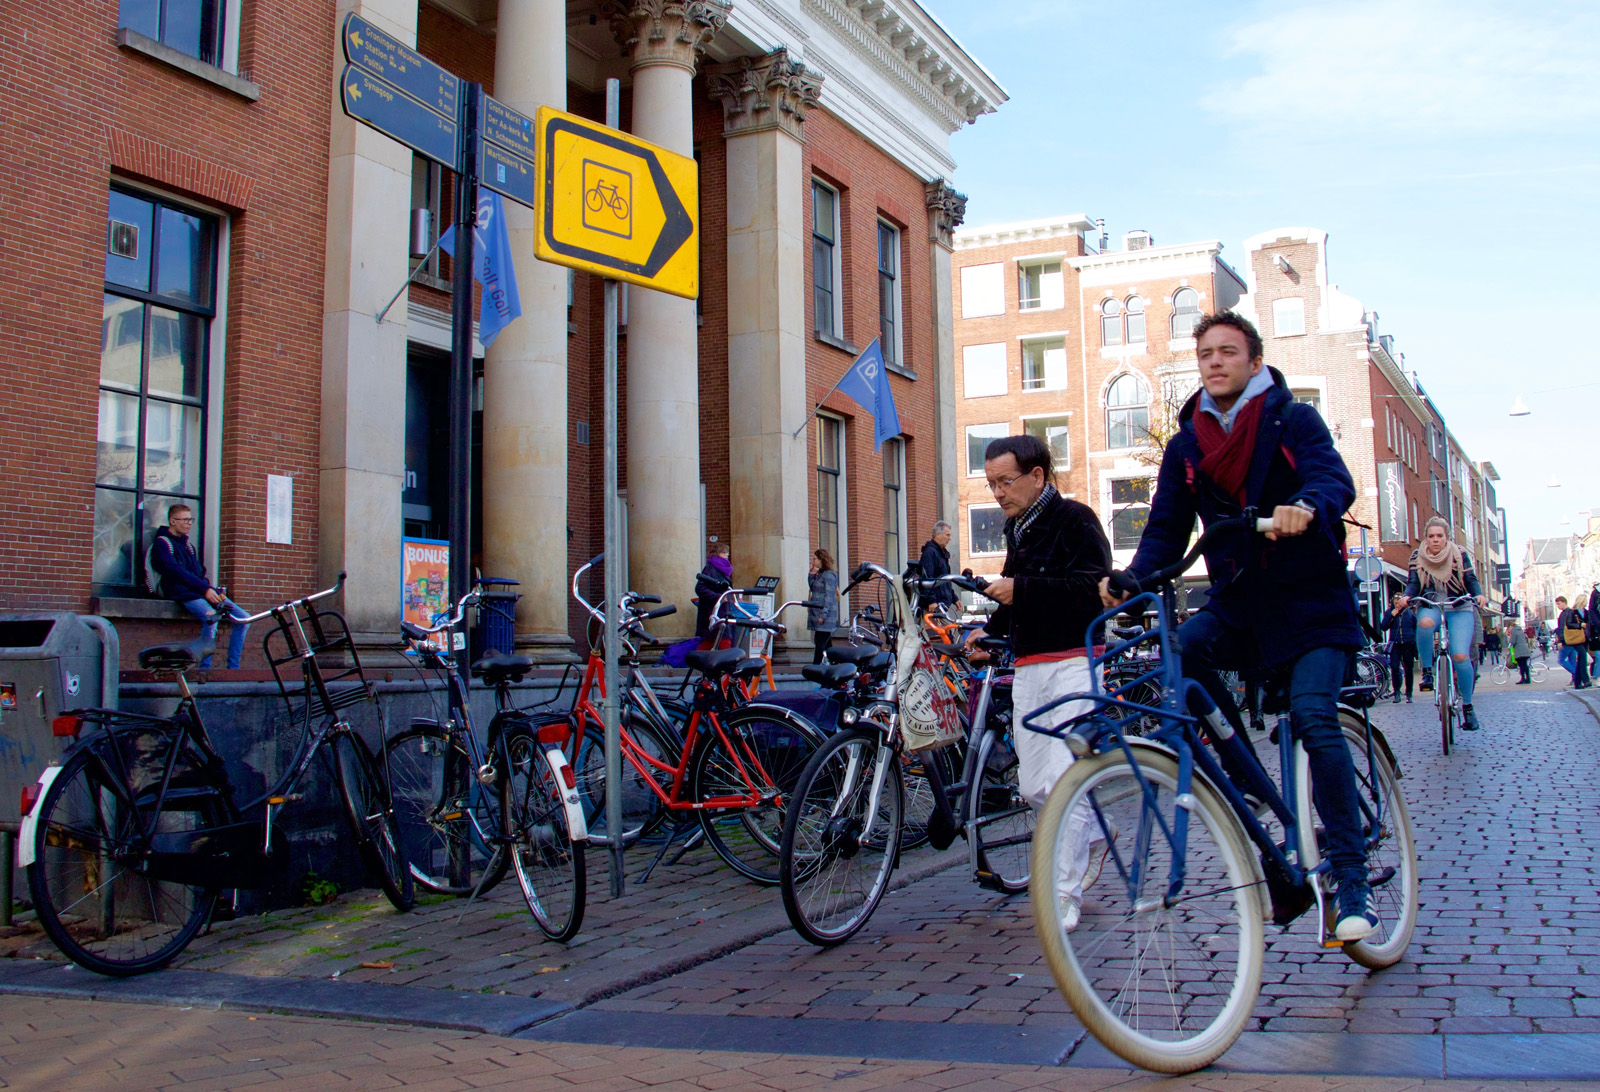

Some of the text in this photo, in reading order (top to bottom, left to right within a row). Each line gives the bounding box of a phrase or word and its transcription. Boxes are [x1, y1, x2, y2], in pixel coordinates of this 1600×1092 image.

[364, 41, 388, 60] Station
[365, 27, 422, 68] Groninger Museum
[363, 54, 384, 73] Politie
[439, 73, 454, 88] 6 min
[363, 78, 394, 102] Synagoge
[439, 86, 454, 100] 8 min
[443, 103, 453, 113] min
[488, 102, 521, 125] Grote Markt
[438, 119, 453, 134] 3 min
[487, 113, 498, 125] Der
[487, 147, 519, 169] Martinikerk
[407, 547, 449, 565] BONUS
